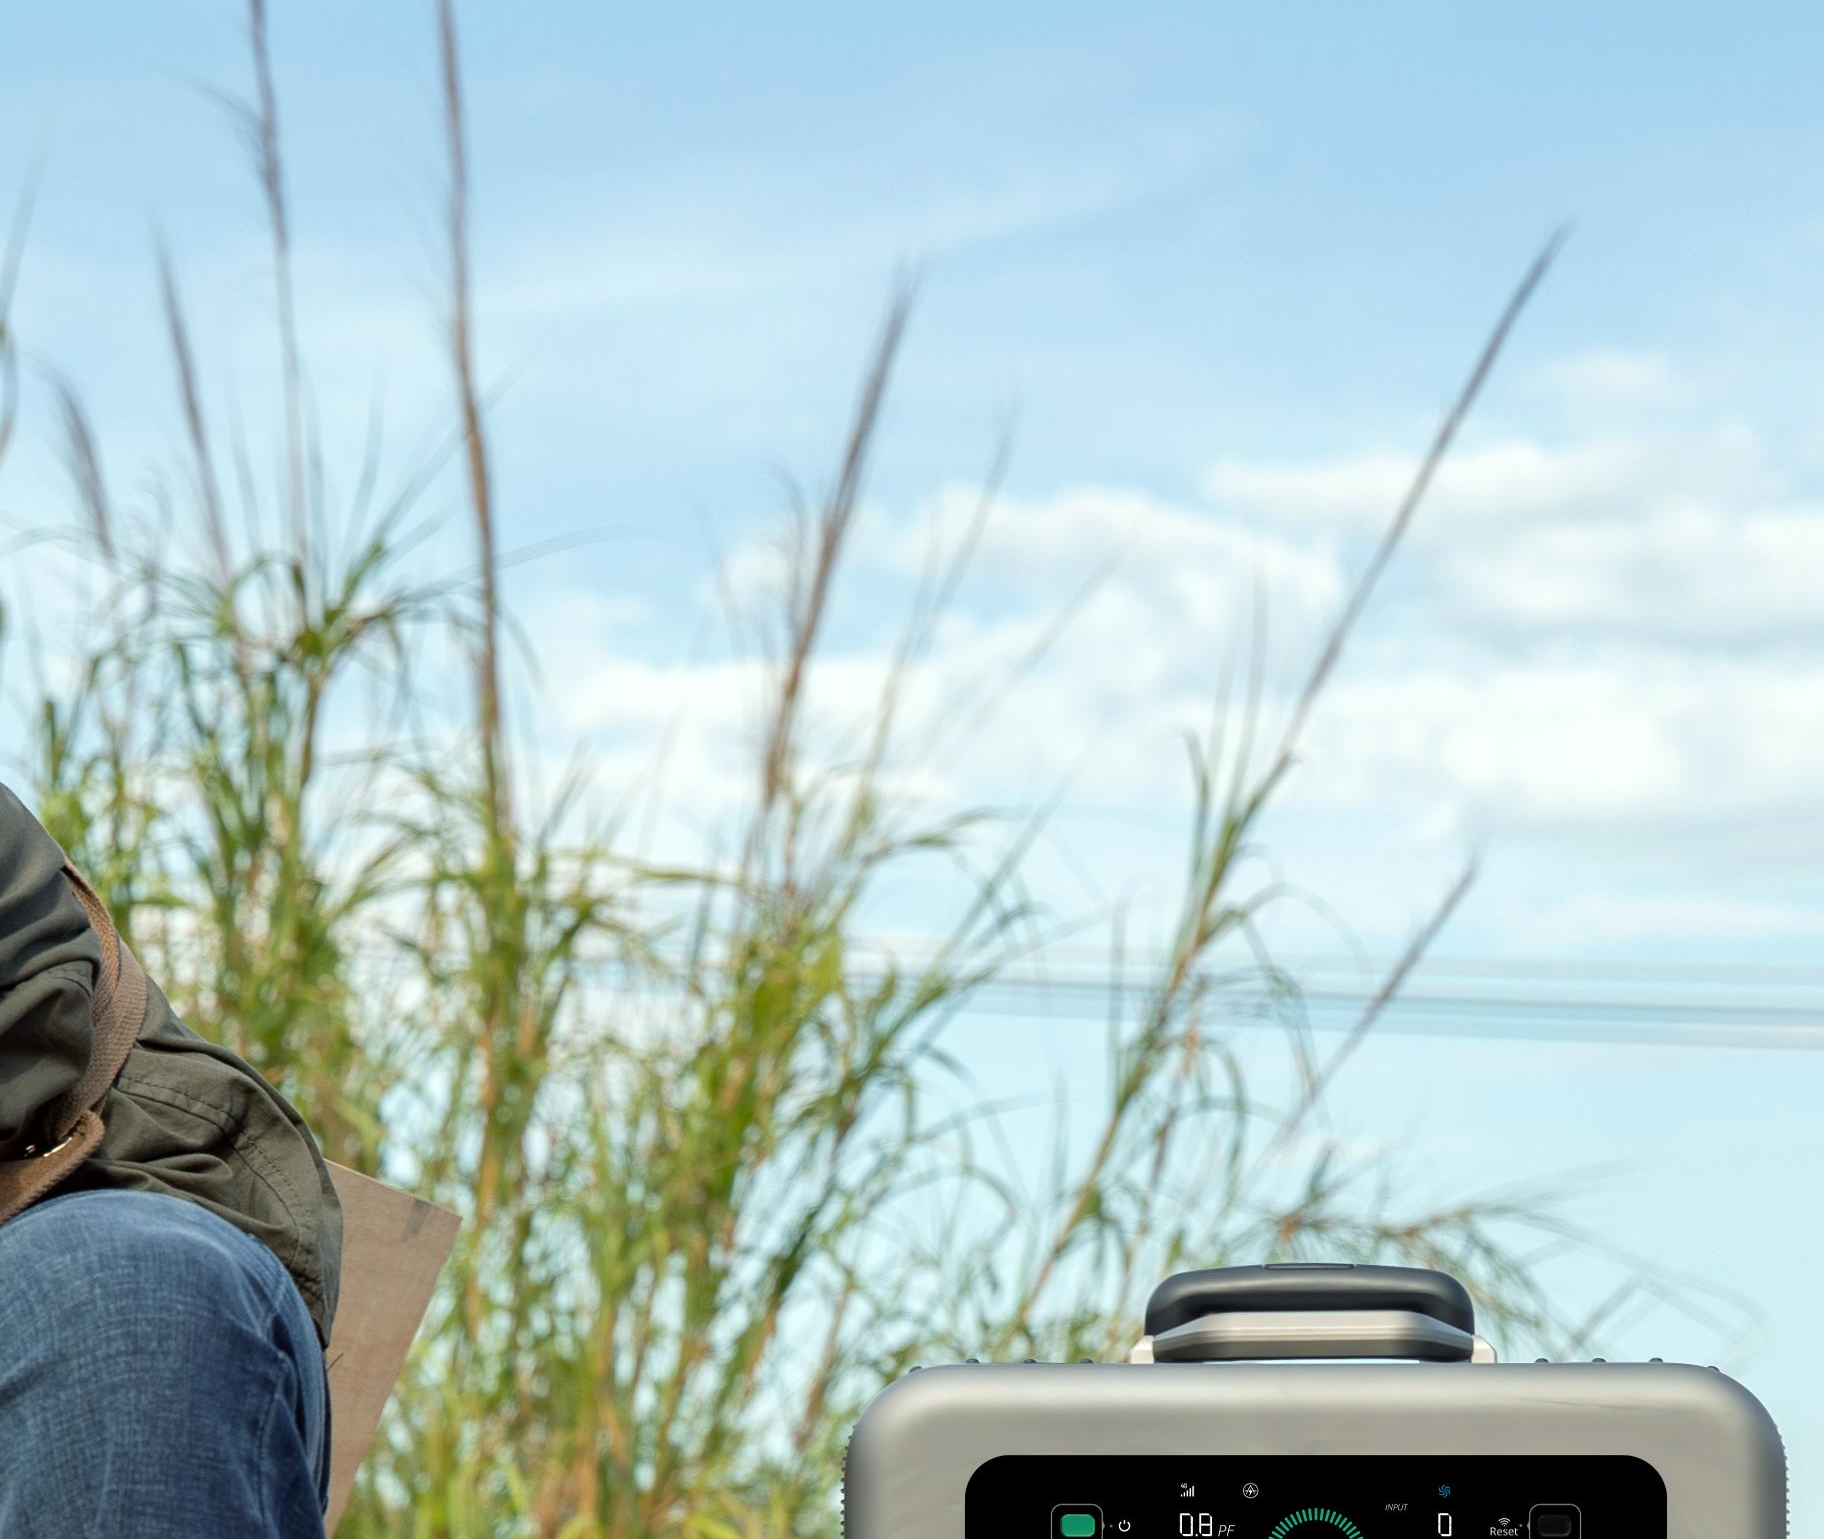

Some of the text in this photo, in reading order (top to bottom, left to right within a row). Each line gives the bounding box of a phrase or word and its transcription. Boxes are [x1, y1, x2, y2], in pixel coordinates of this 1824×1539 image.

[1180, 1513, 1236, 1537] 0.8 PF
[1489, 1524, 1519, 1537] Reset
